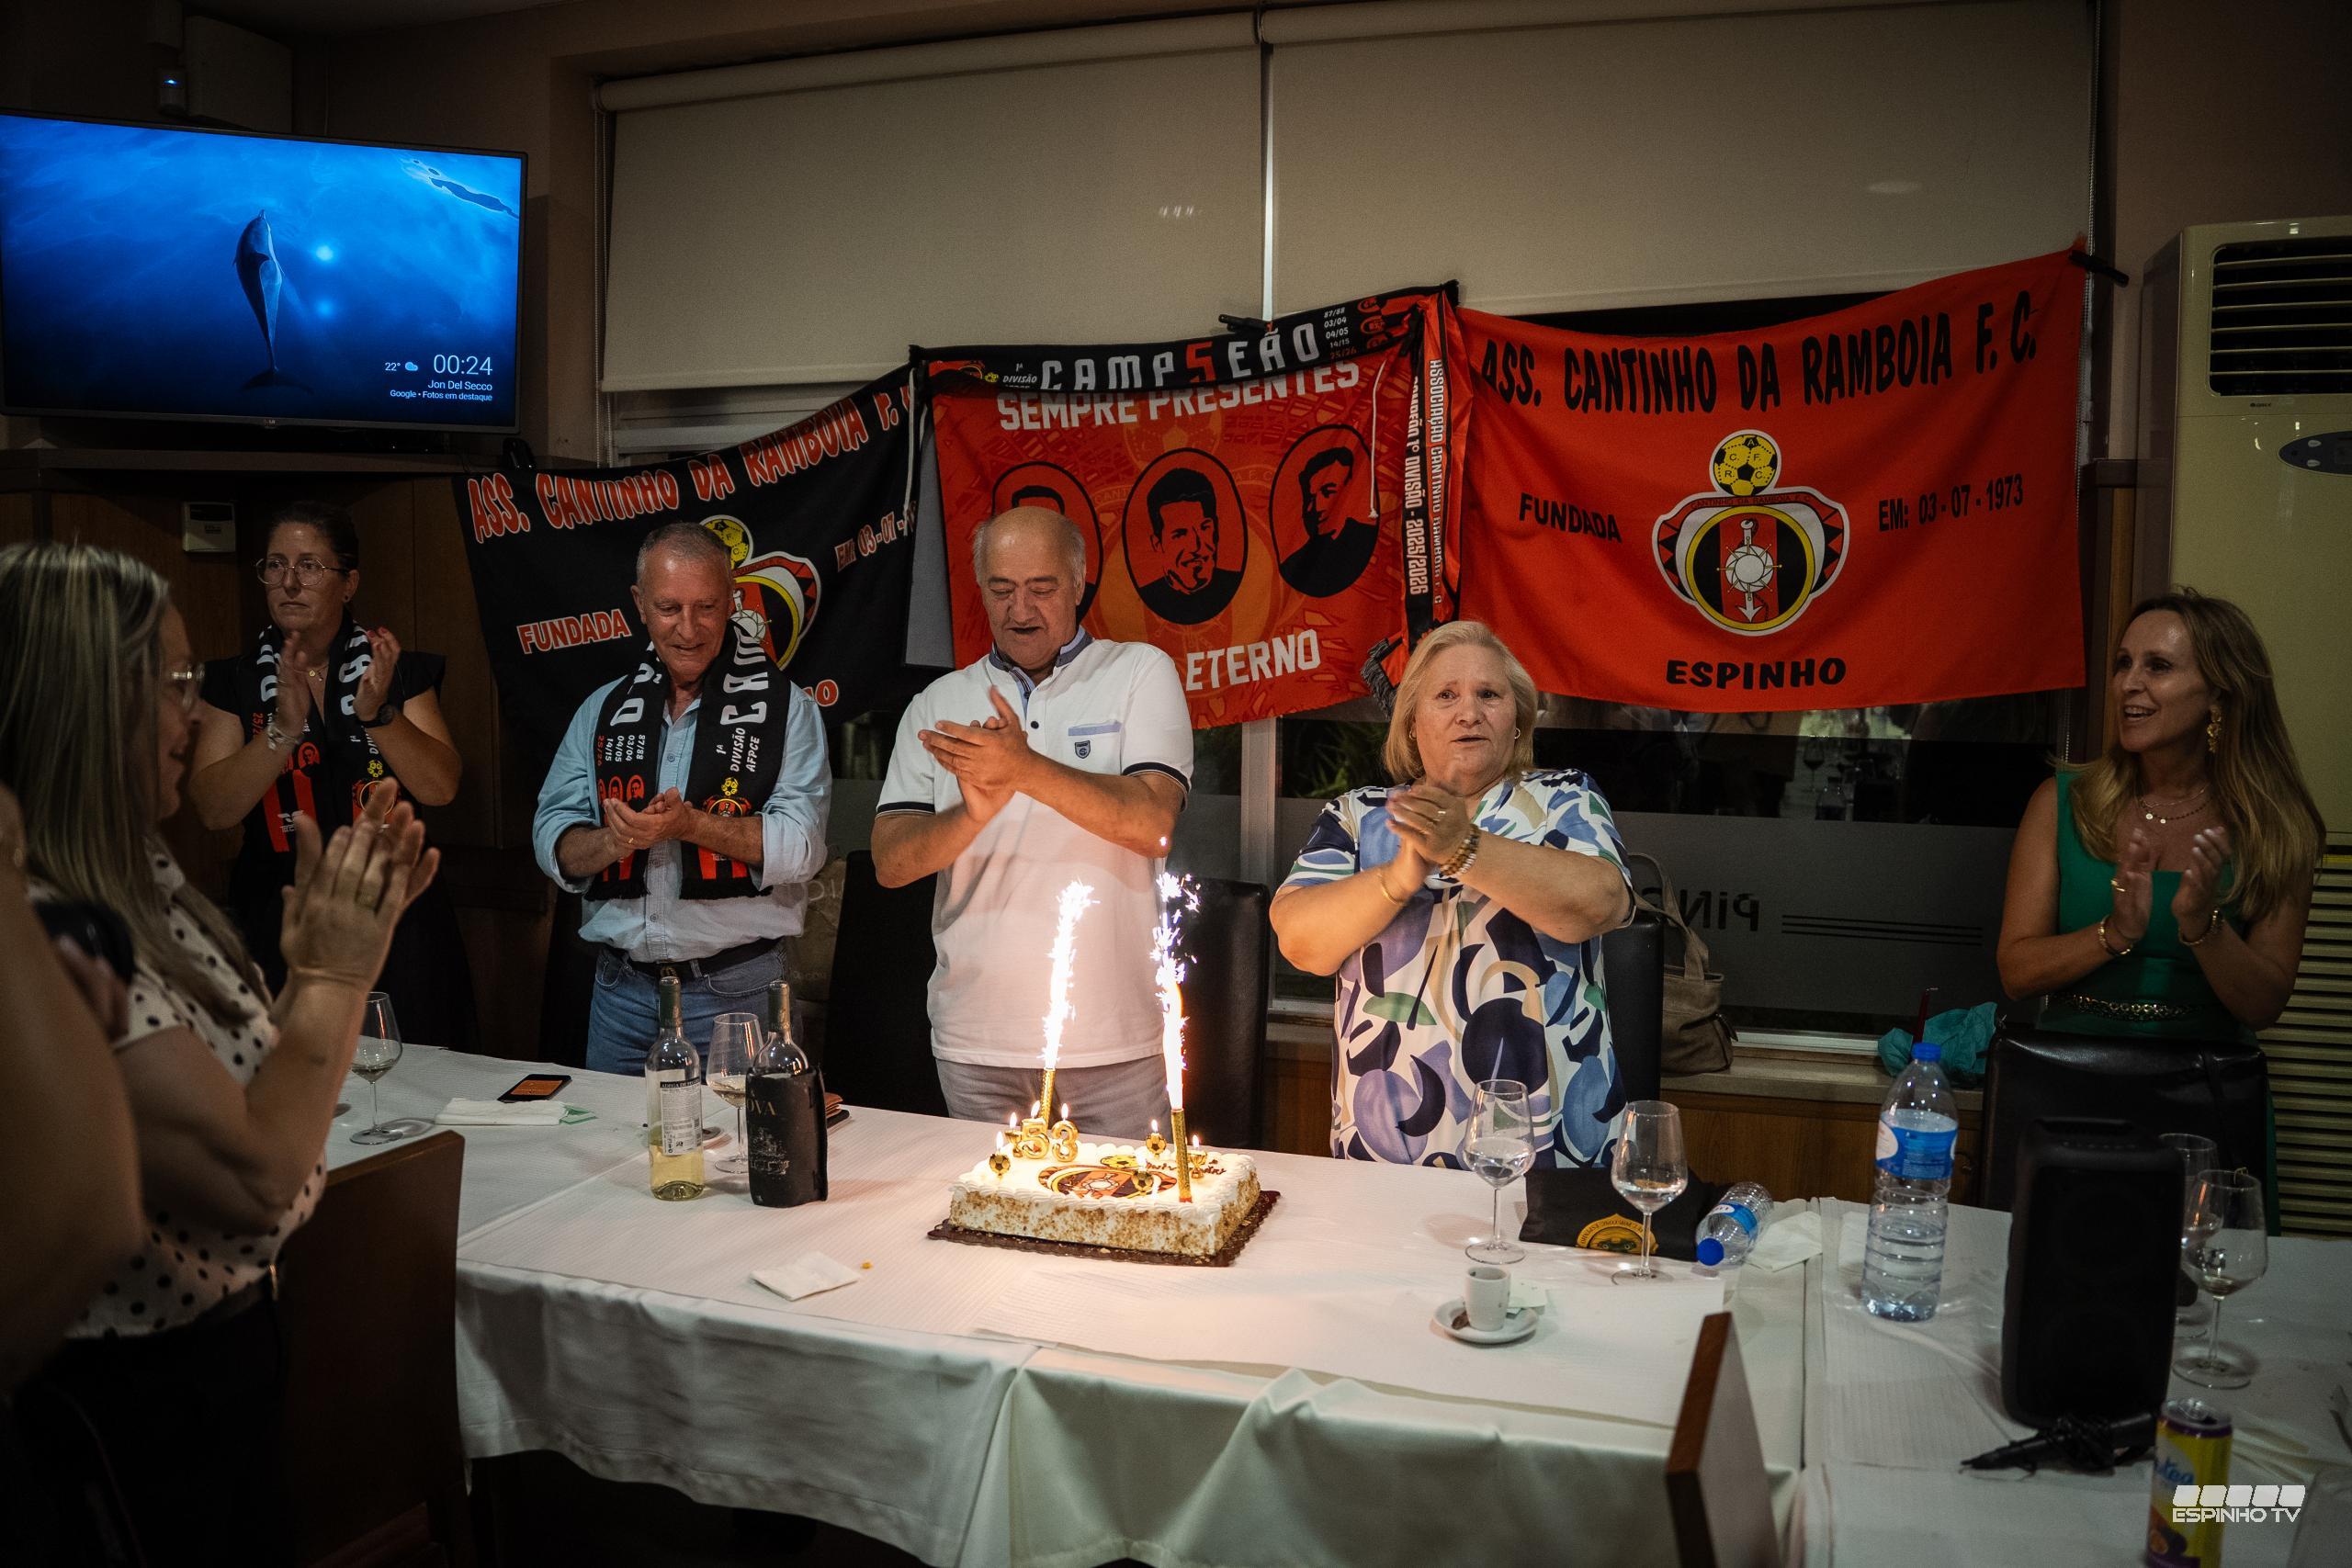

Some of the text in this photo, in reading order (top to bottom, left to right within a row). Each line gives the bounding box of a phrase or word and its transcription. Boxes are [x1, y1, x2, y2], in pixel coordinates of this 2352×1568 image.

[1326, 327, 1349, 339] 04/05
[433, 355, 492, 376] 00:24
[1002, 373, 1037, 384] DIVISÃO
[1482, 338, 1541, 407] ASS.
[1565, 342, 1717, 415] CANTINHO
[1737, 341, 1781, 413] DA
[1801, 310, 1953, 407] RAMBOIA
[390, 389, 416, 398] Google
[423, 390, 444, 399] Fotos
[458, 392, 492, 401] destaque
[428, 380, 492, 391] Jon Del Secco
[997, 360, 1360, 431] SEMPRE PRESENTES
[468, 473, 530, 543] ASS.
[536, 468, 679, 529] CANTINHO
[688, 454, 735, 502] DA
[739, 398, 869, 487] RAMBOIA
[1404, 456, 1426, 509] DIVISÃO
[1430, 446, 1443, 513] CANTINHO
[1519, 491, 1623, 544] FUNDADA
[1878, 498, 1910, 533] EM:
[1406, 518, 1429, 595] 2025/2026
[516, 609, 633, 655] FUNDADA
[1185, 628, 1320, 693] ETERNO
[1665, 657, 1847, 691] ESPINHO
[605, 738, 614, 761] 14/15
[615, 735, 625, 762] 04/05
[625, 734, 636, 762] 03/04
[636, 734, 646, 761] 87/88
[729, 727, 746, 773] DIVISÃO
[745, 735, 760, 773] AFPCE
